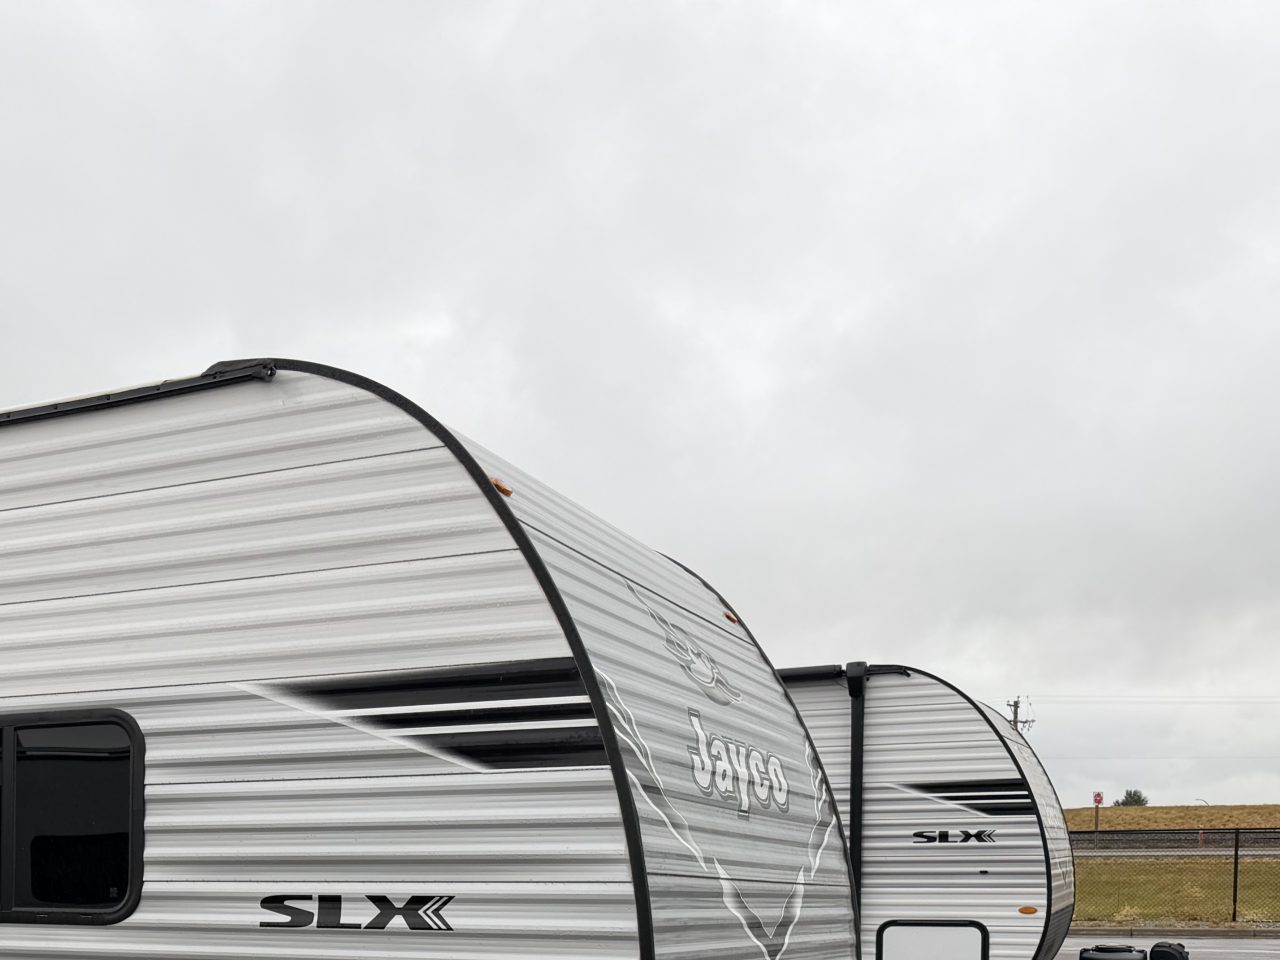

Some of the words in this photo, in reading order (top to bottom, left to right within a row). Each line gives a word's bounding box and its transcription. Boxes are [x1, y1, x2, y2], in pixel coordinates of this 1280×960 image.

[687, 707, 789, 821] Jayco
[913, 830, 996, 844] SLX
[259, 894, 456, 931] SLX
